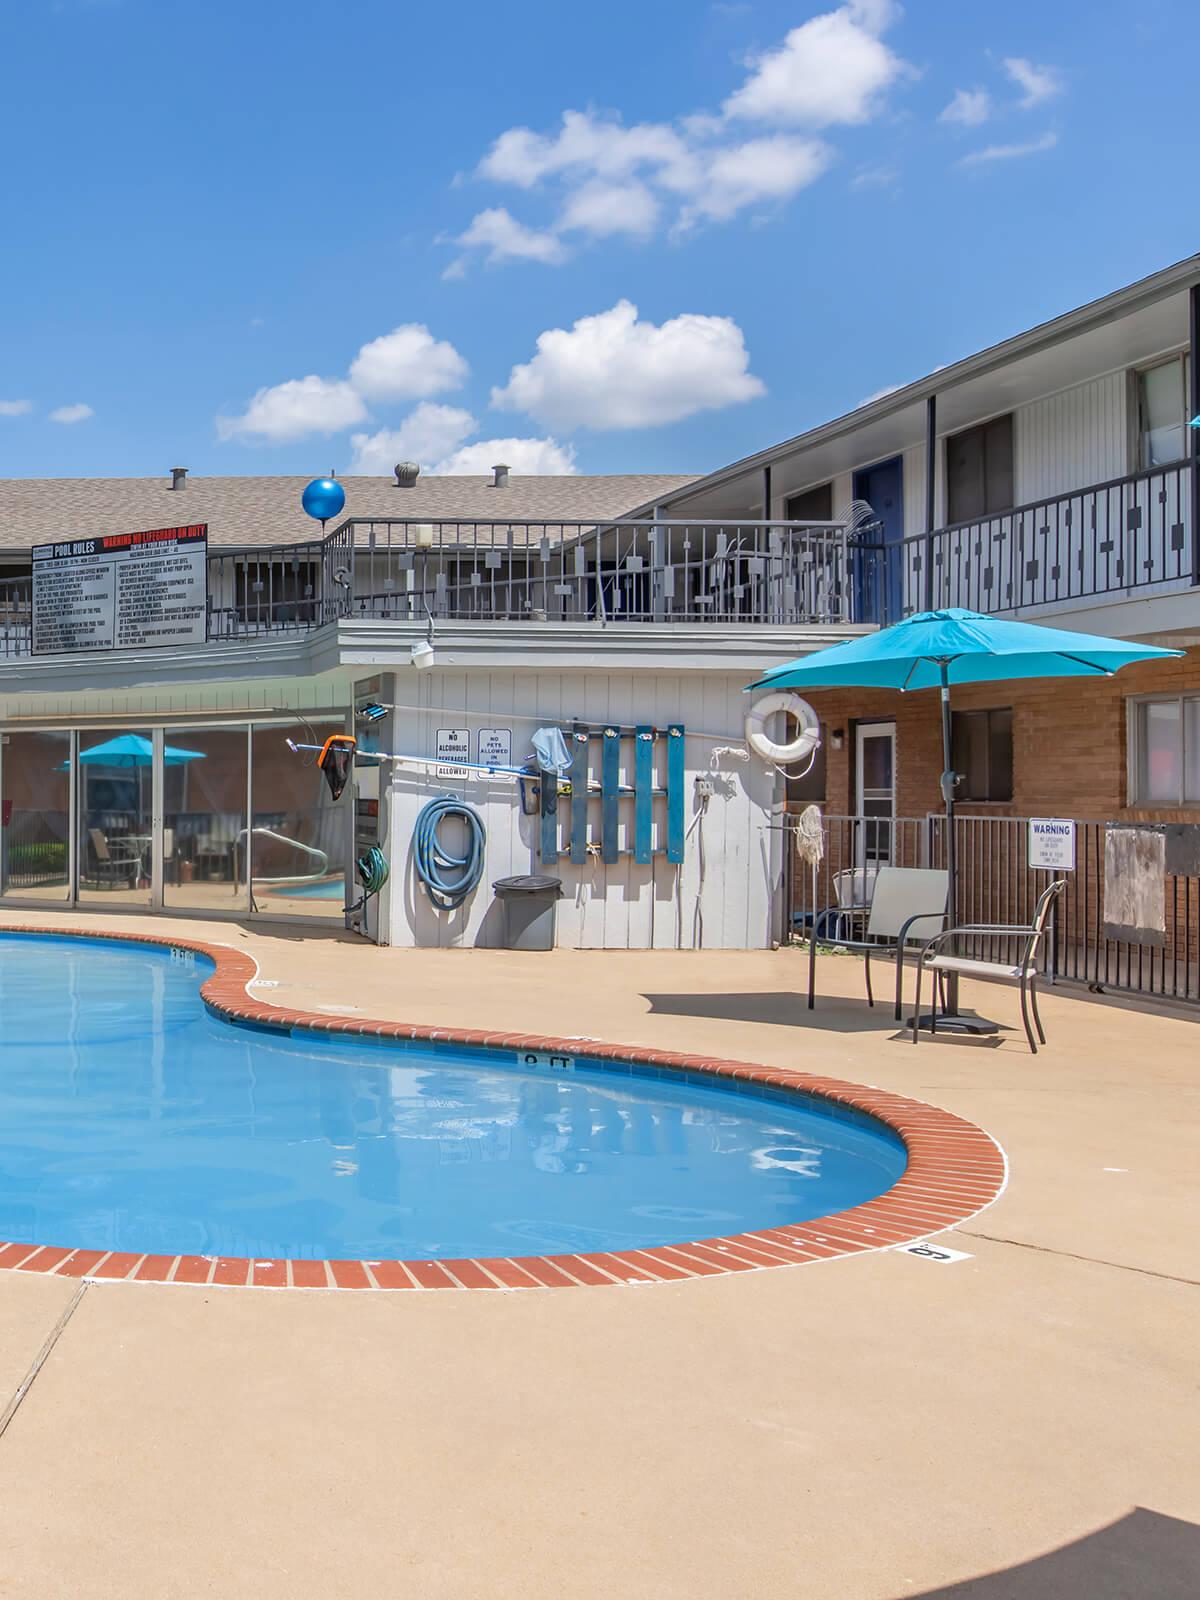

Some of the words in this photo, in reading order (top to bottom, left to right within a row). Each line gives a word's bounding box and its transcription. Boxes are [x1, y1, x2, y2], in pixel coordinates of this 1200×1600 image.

[103, 535, 131, 547] WARNING
[133, 534, 141, 543] NO
[143, 529, 176, 542] LIFEGUARD
[178, 528, 186, 538] ON
[188, 526, 205, 537] DUTY
[54, 542, 71, 556] POOL
[73, 540, 94, 554] RULES
[1034, 824, 1070, 835] WARNING
